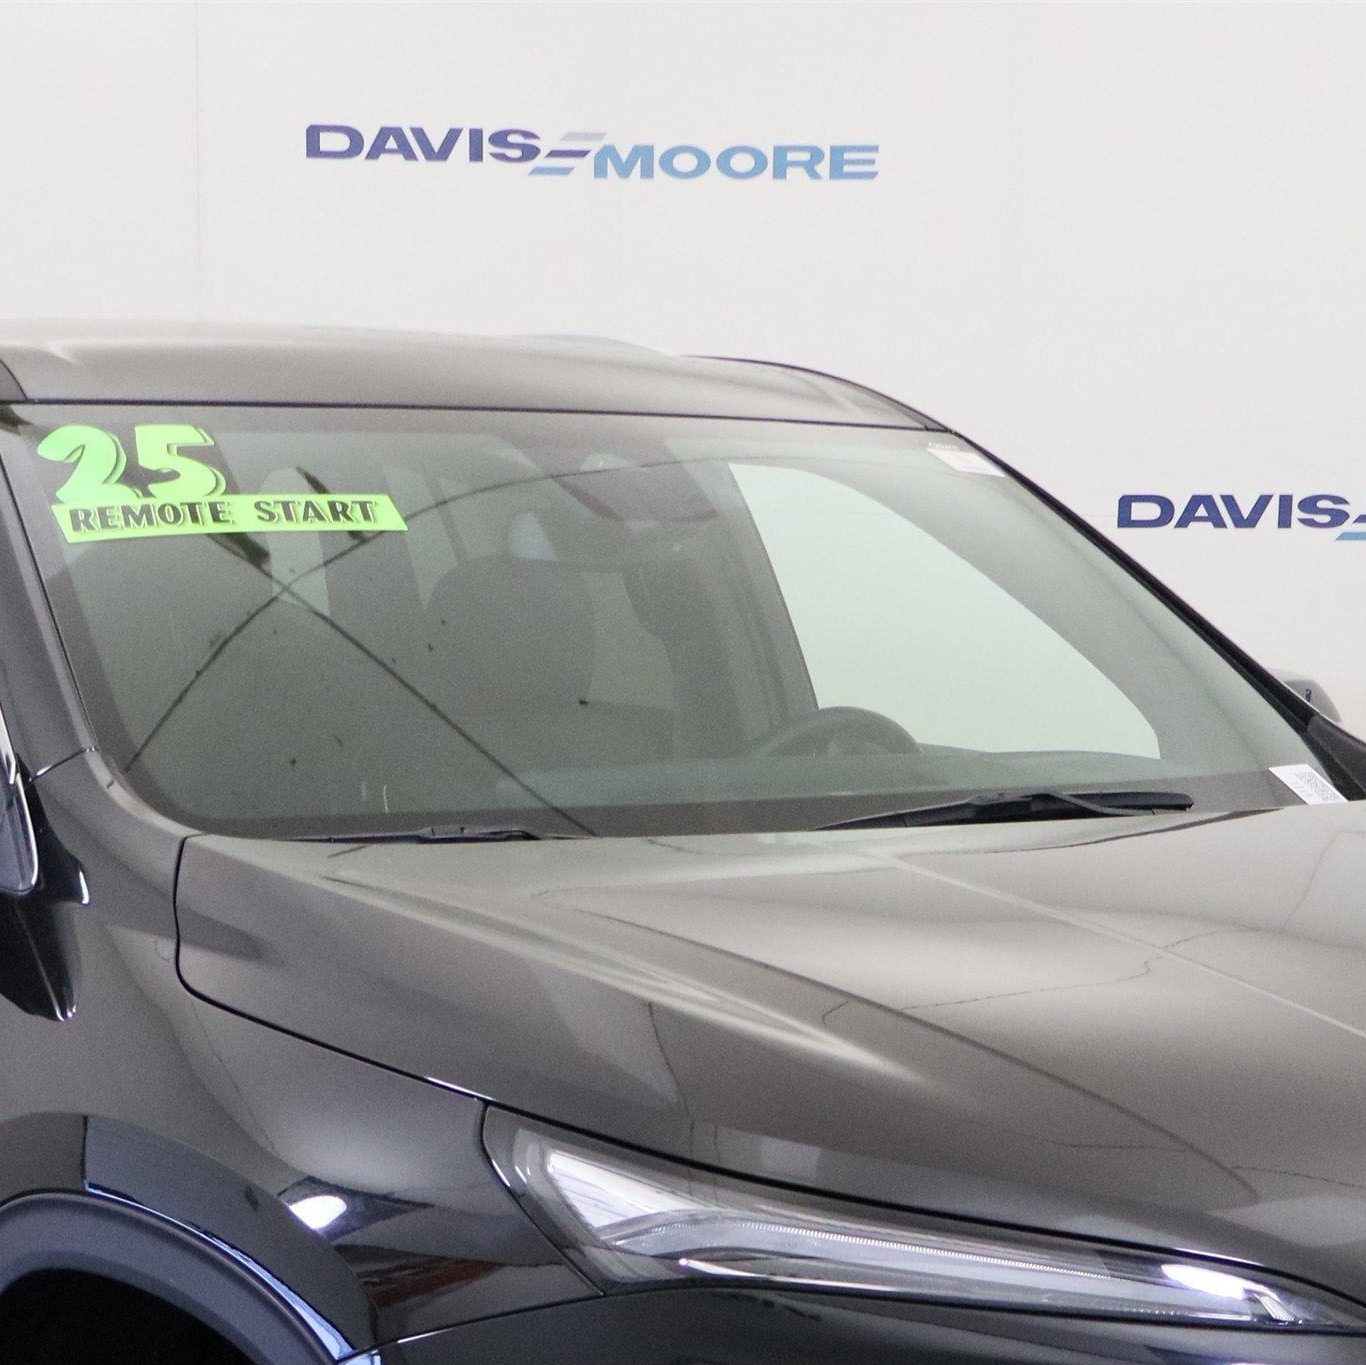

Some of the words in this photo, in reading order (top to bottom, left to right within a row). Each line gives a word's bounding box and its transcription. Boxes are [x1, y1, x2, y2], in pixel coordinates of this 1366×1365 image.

[306, 124, 540, 162] DAVIS
[593, 145, 879, 179] MOORE
[37, 424, 226, 502] 25
[69, 501, 234, 533] REMOTE
[254, 500, 378, 524] START
[1117, 493, 1349, 529] DAVIS
